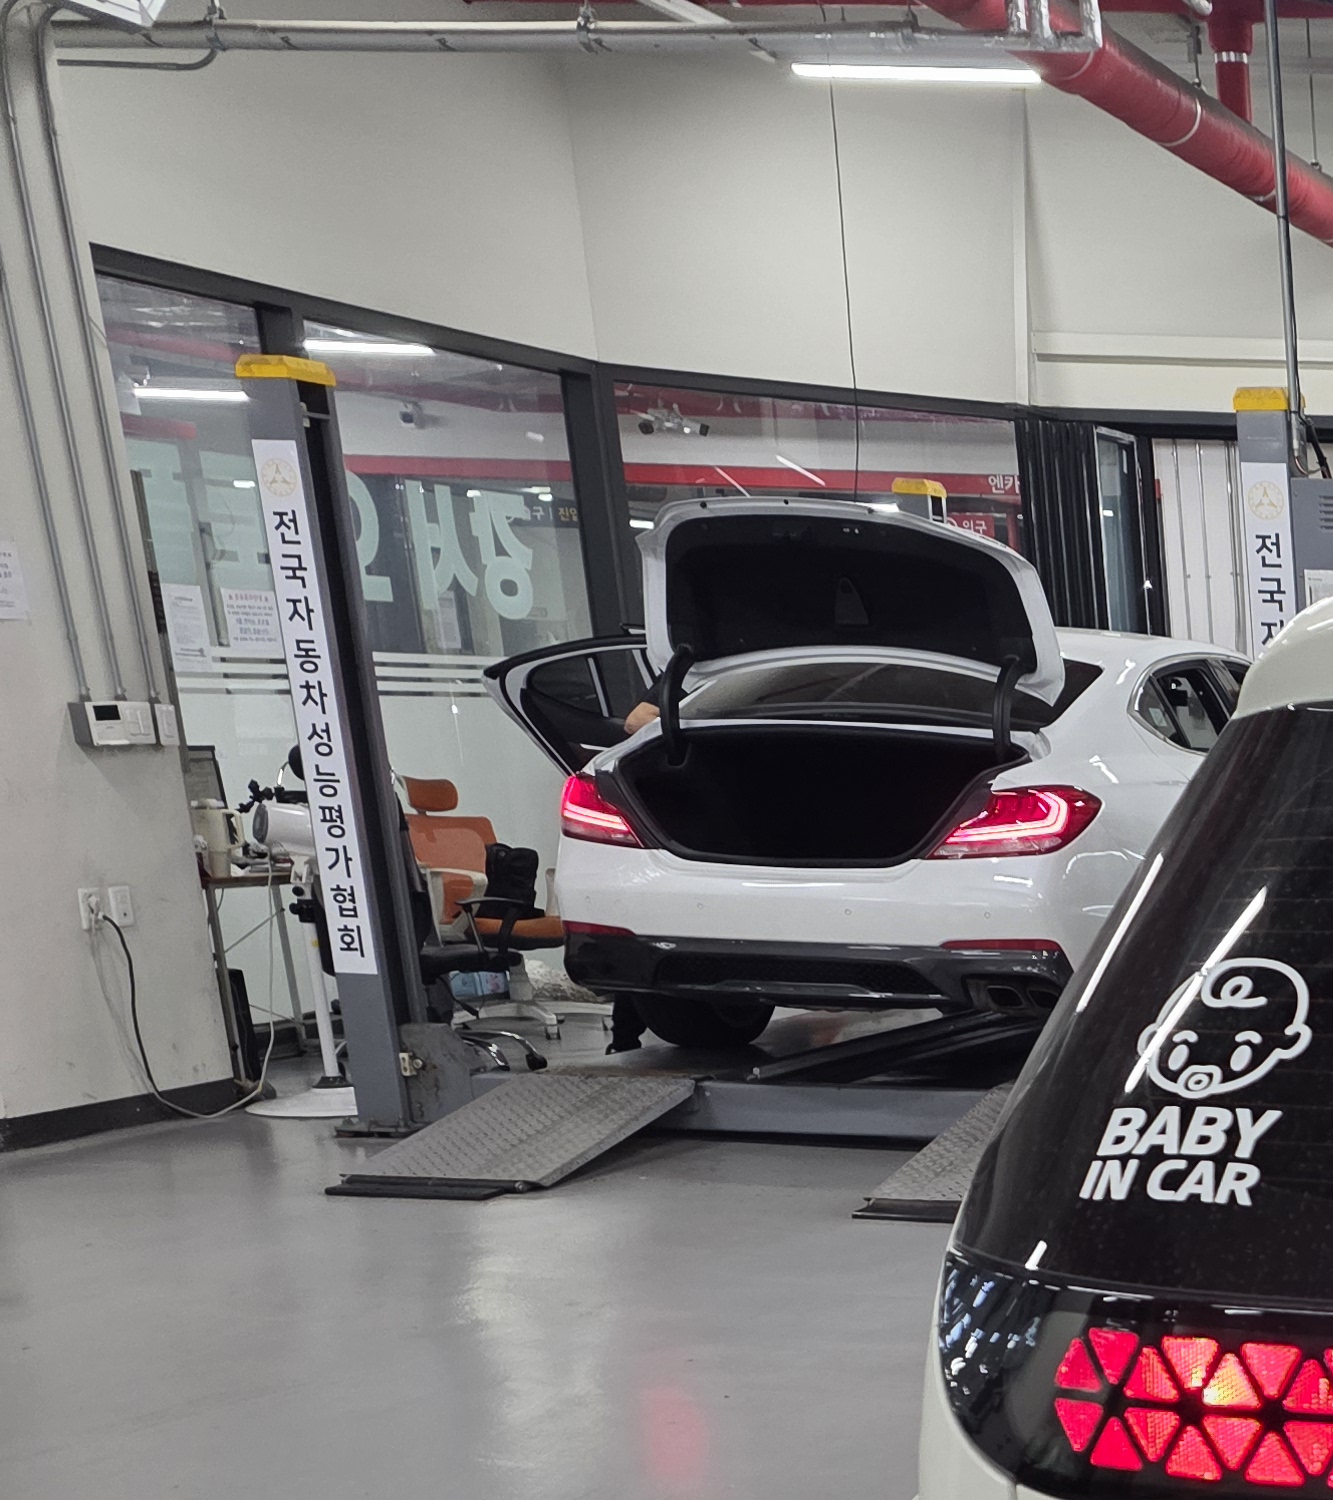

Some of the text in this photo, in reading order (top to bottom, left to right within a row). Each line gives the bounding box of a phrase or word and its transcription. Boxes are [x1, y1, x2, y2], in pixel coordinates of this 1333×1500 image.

[272, 509, 366, 958] 전국자동차성능평가협회
[1096, 1105, 1283, 1159] BABY
[1079, 1158, 1262, 1206] IN CAR
